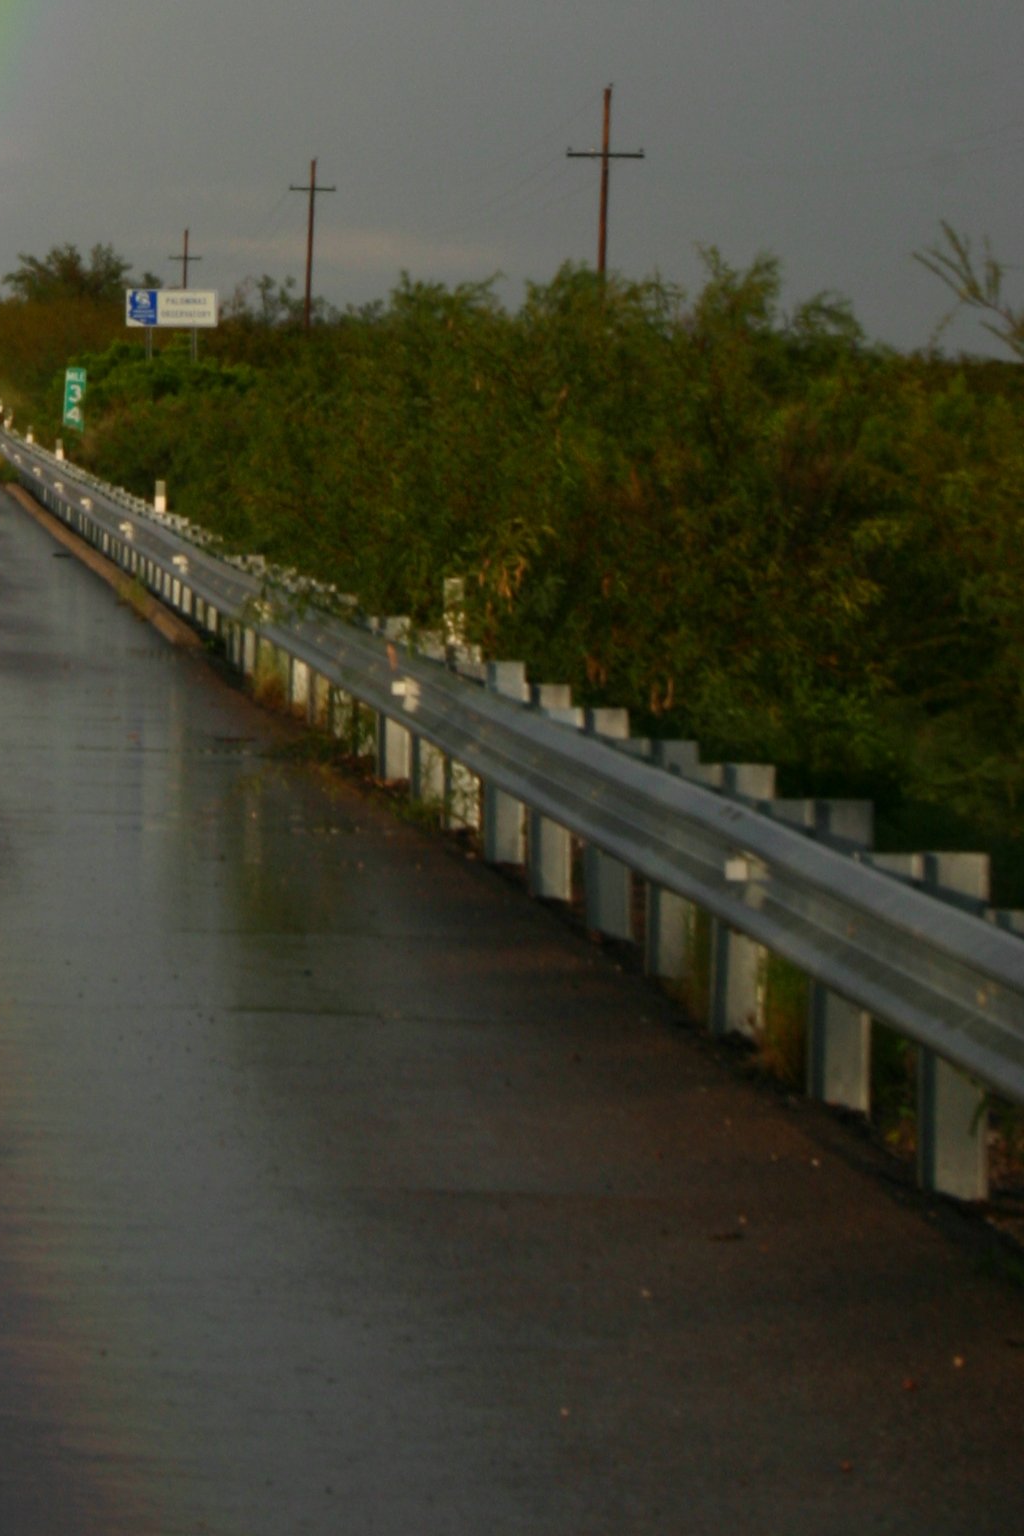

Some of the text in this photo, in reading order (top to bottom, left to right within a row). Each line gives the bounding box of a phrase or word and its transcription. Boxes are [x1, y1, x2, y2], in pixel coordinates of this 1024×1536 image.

[66, 371, 85, 382] MILE
[69, 384, 82, 402] 3
[66, 406, 81, 423] 4
